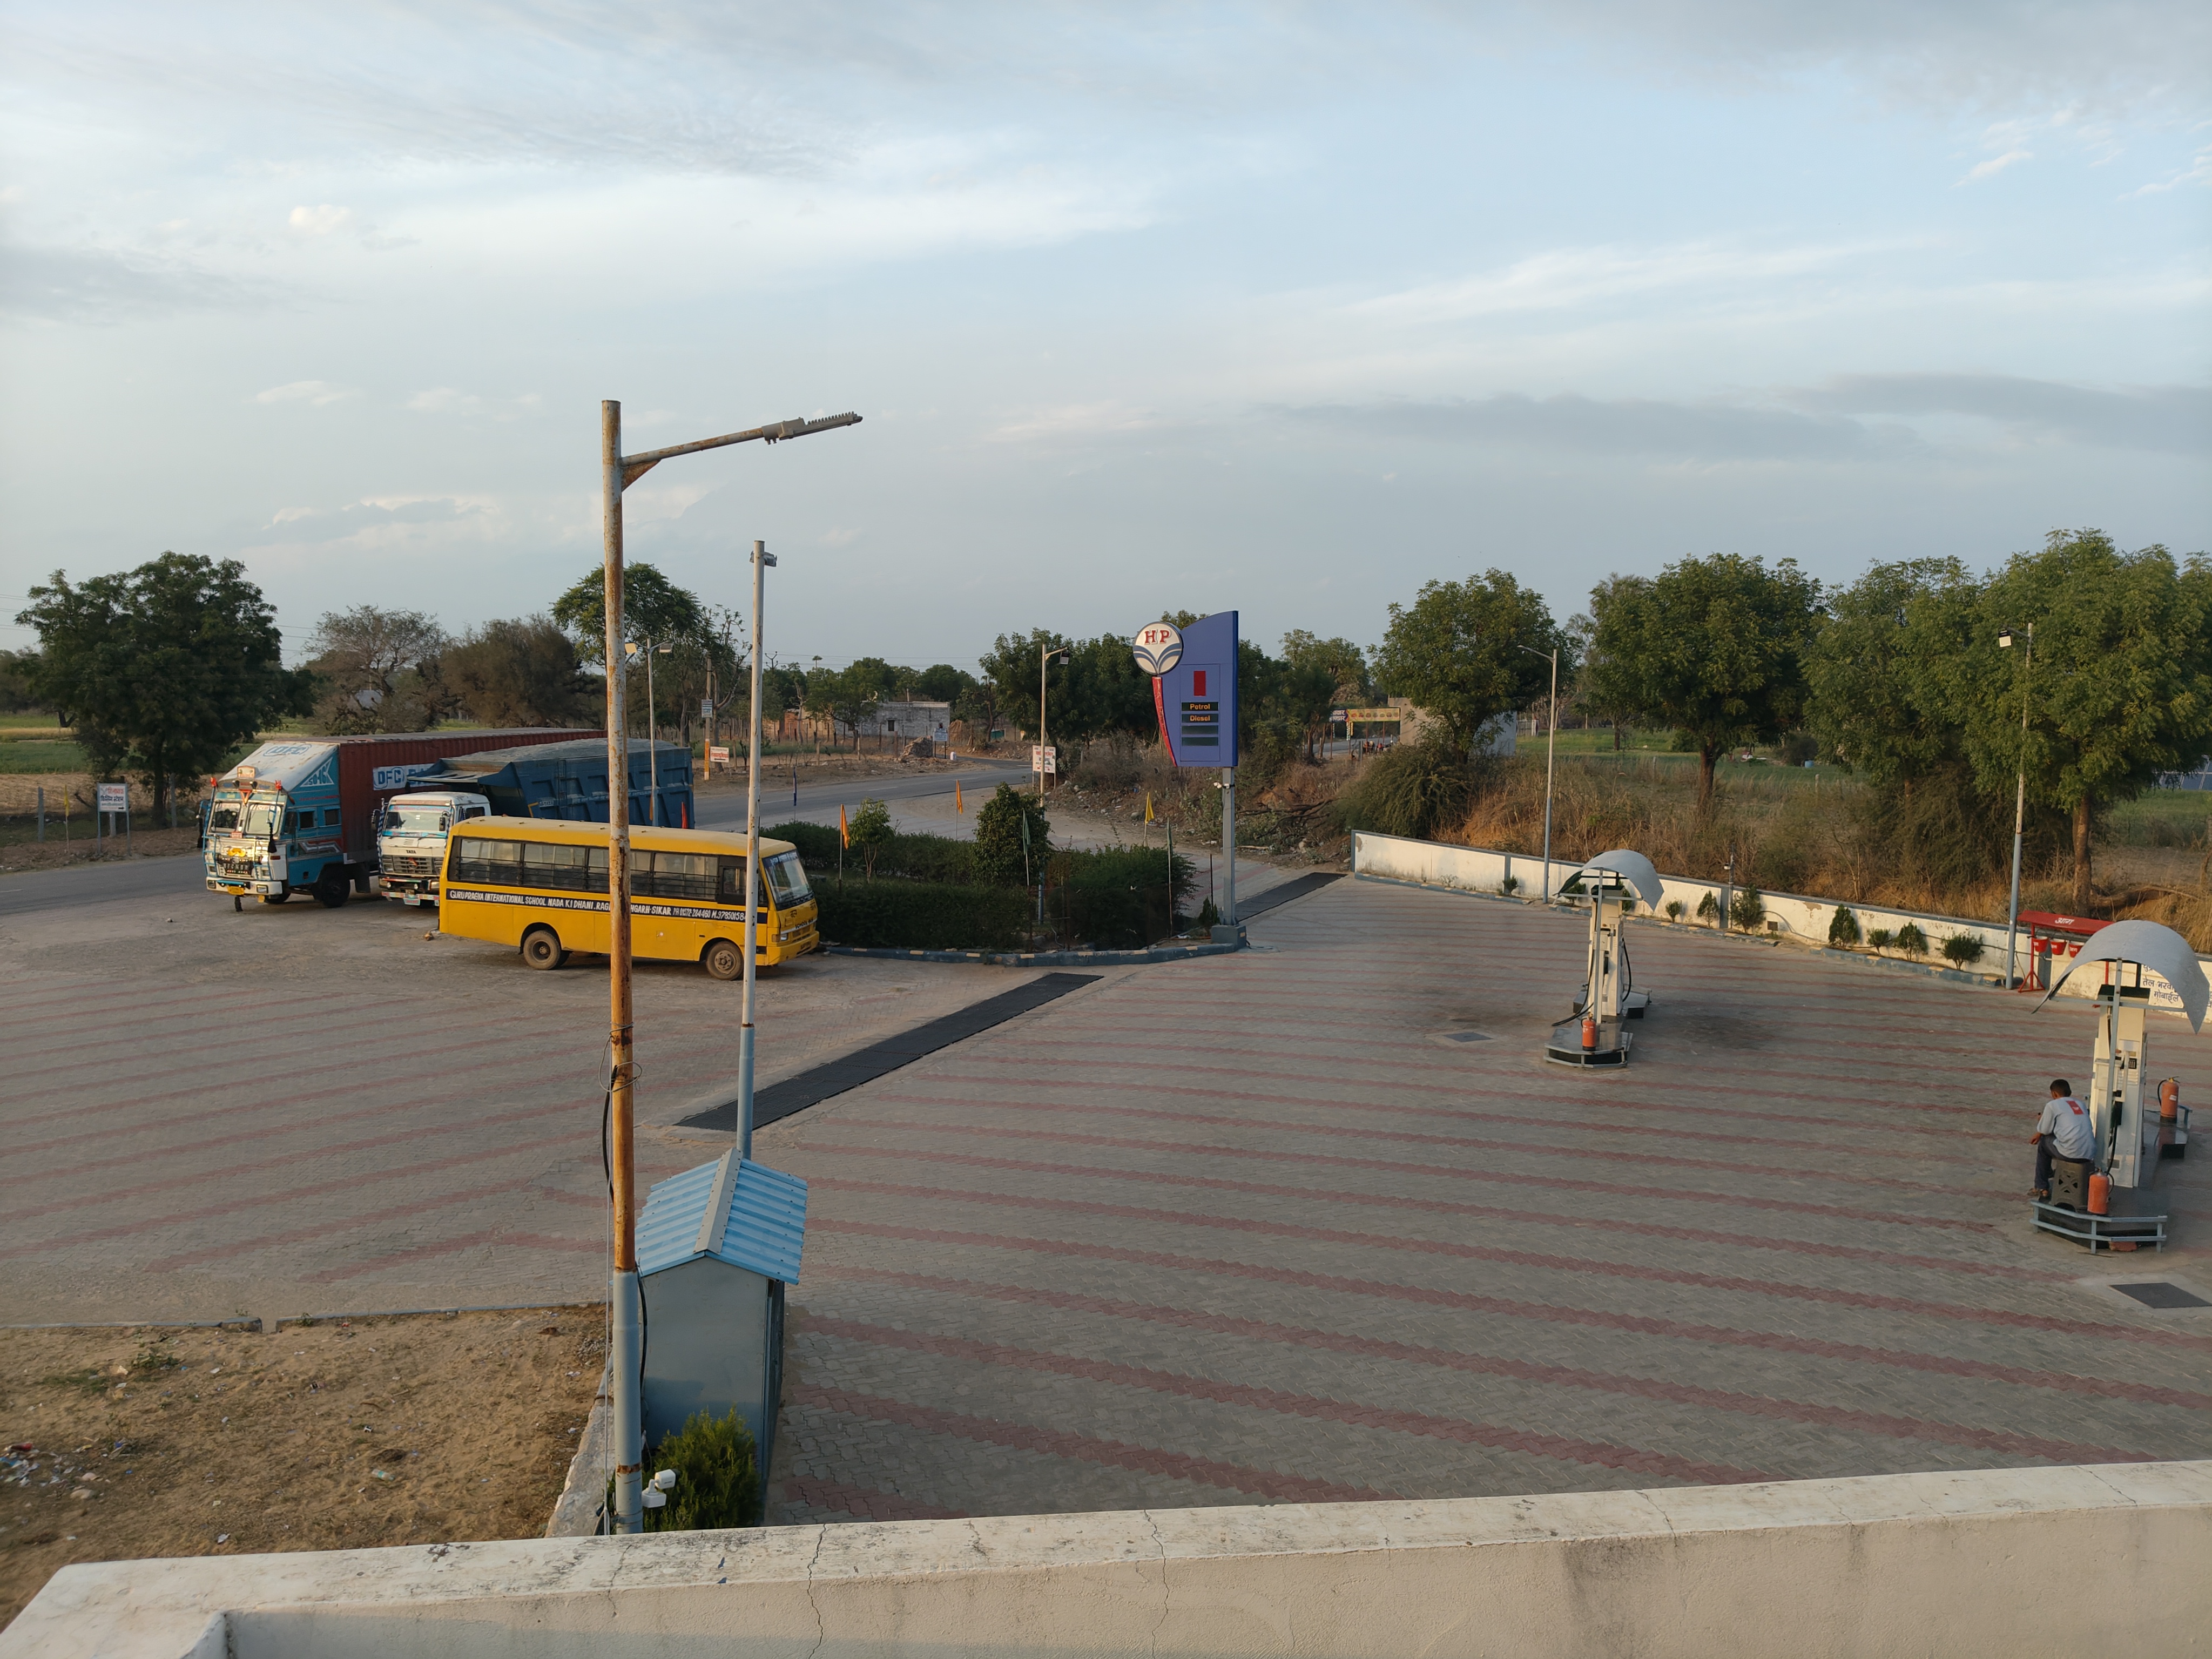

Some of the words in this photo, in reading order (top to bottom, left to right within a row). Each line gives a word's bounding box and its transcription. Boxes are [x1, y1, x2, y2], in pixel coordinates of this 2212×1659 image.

[378, 770, 401, 784] DFC
[484, 893, 525, 904] INTERNATIONAL
[548, 898, 564, 907] NADA
[2142, 975, 2155, 987] तेल
[2154, 989, 2180, 1004] मोबाईल
